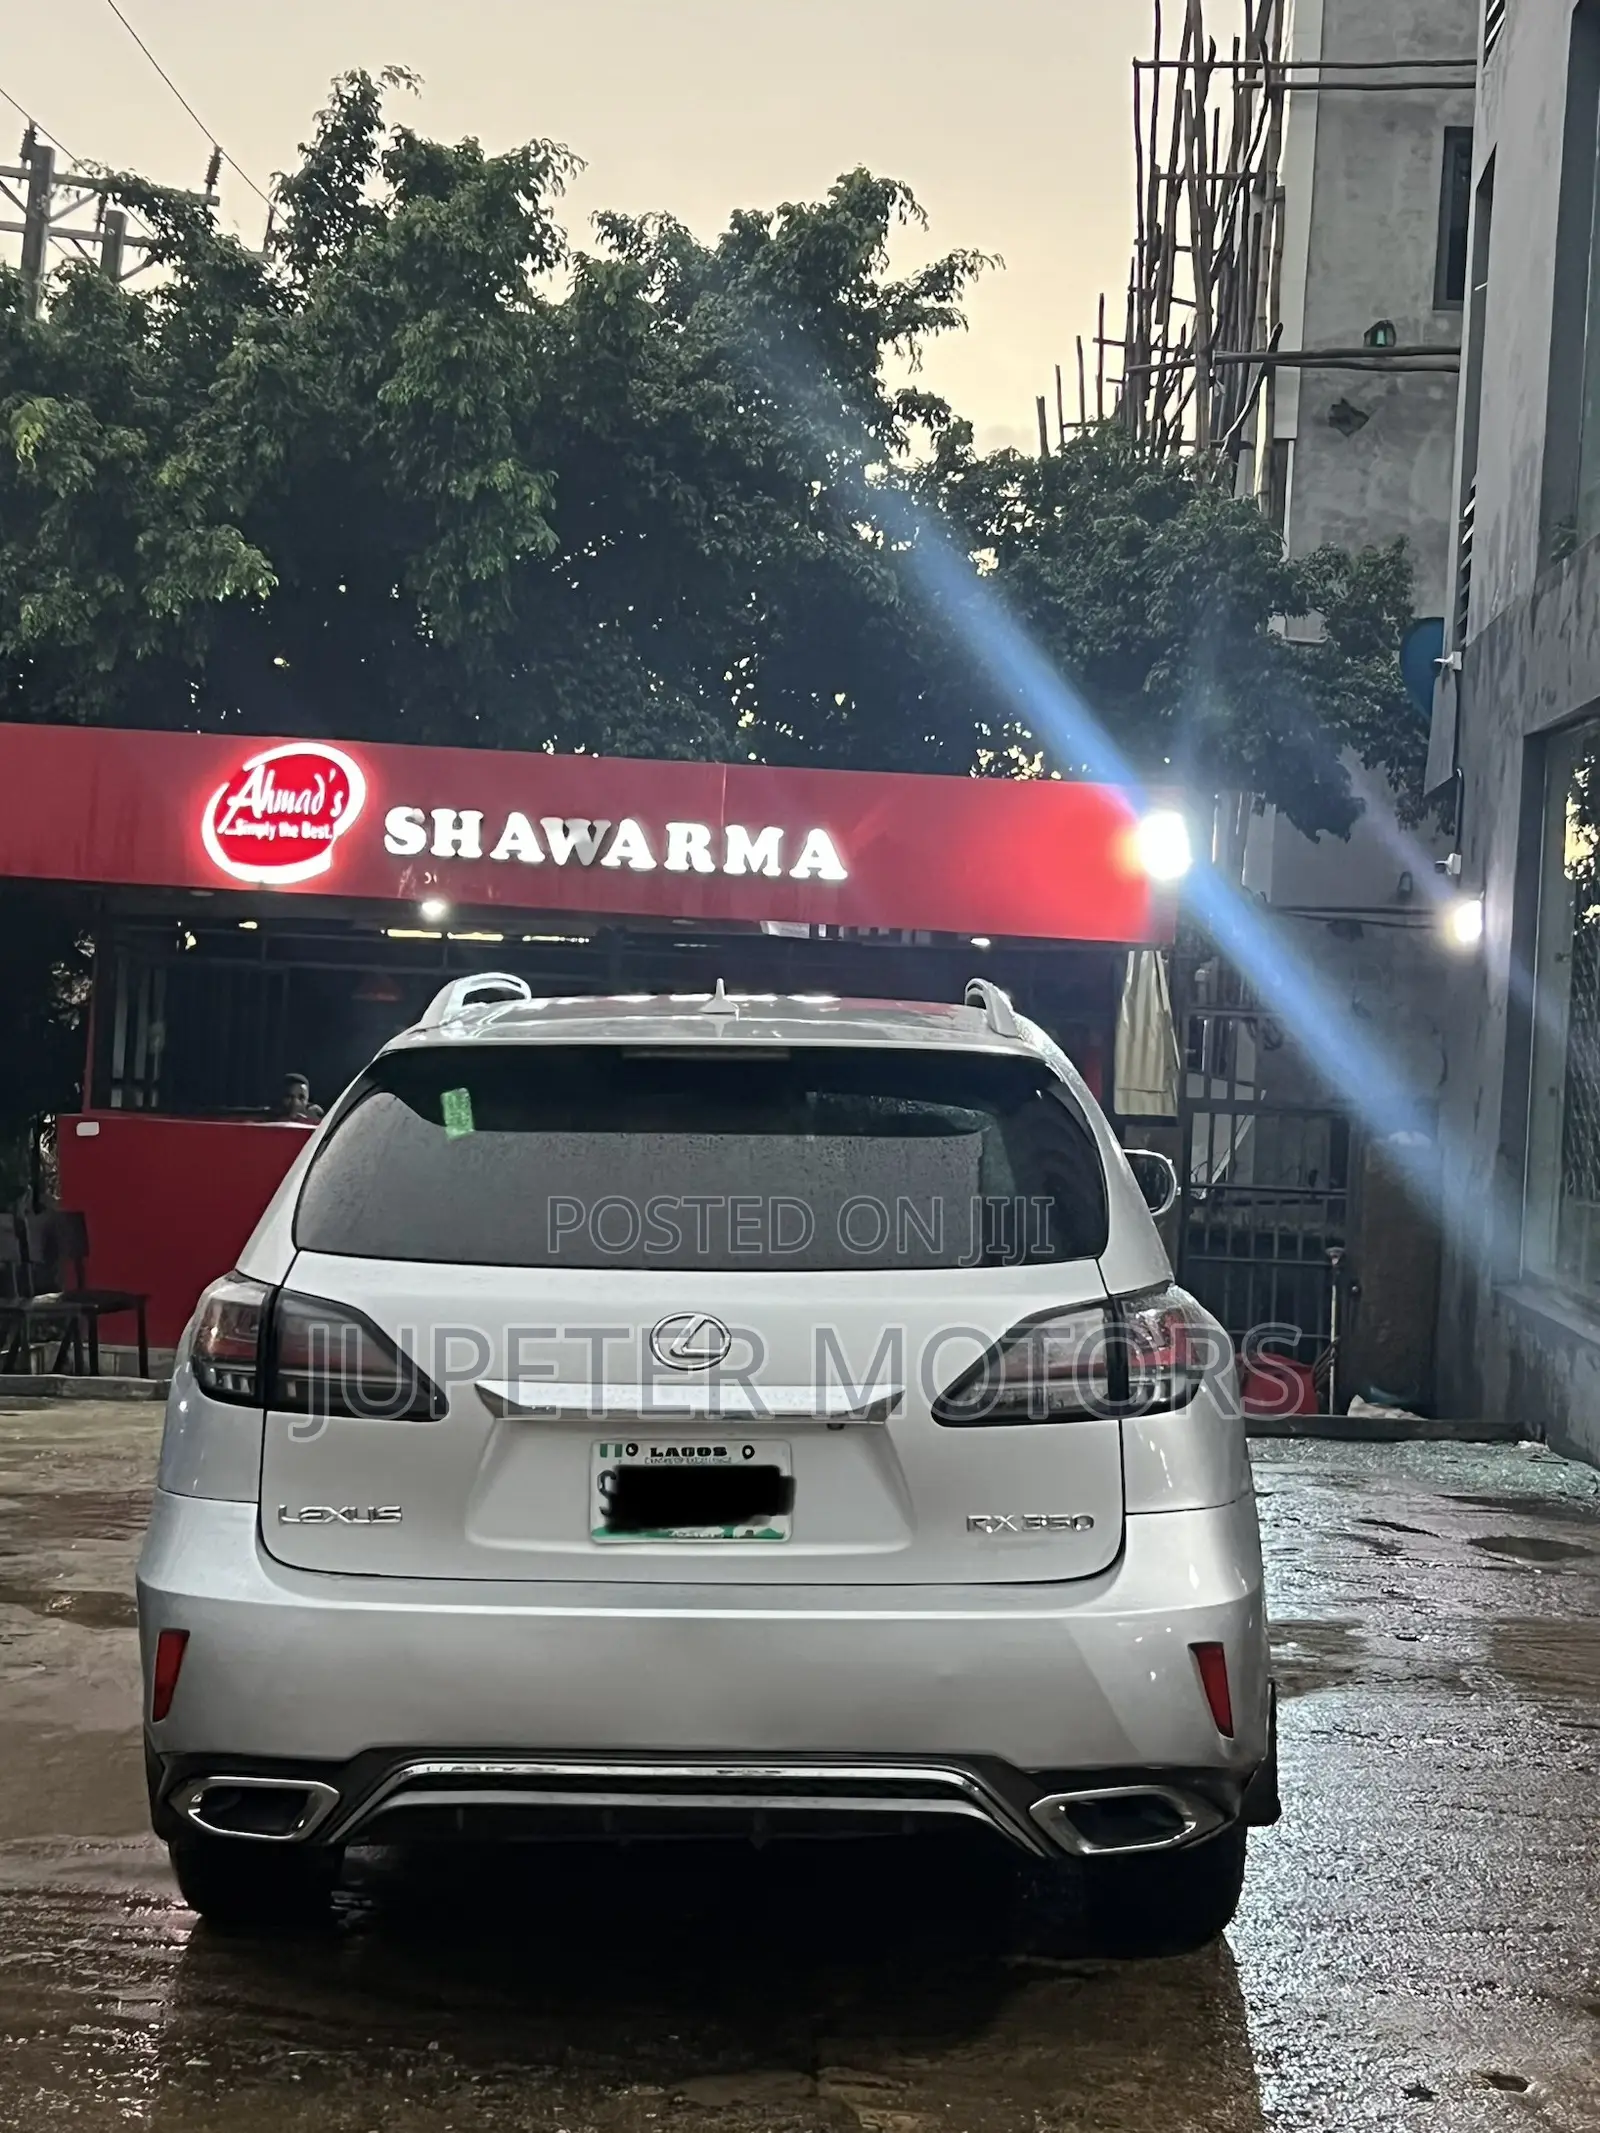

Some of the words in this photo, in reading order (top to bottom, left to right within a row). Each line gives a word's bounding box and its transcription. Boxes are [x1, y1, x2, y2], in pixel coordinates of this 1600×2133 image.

[217, 764, 344, 833] Ahmad's
[383, 806, 848, 881] SHAWARMA
[650, 1446, 728, 1458] LAGOS
[278, 1504, 402, 1526] LEXUS
[967, 1511, 1018, 1533] RX
[1021, 1512, 1095, 1533] 350
